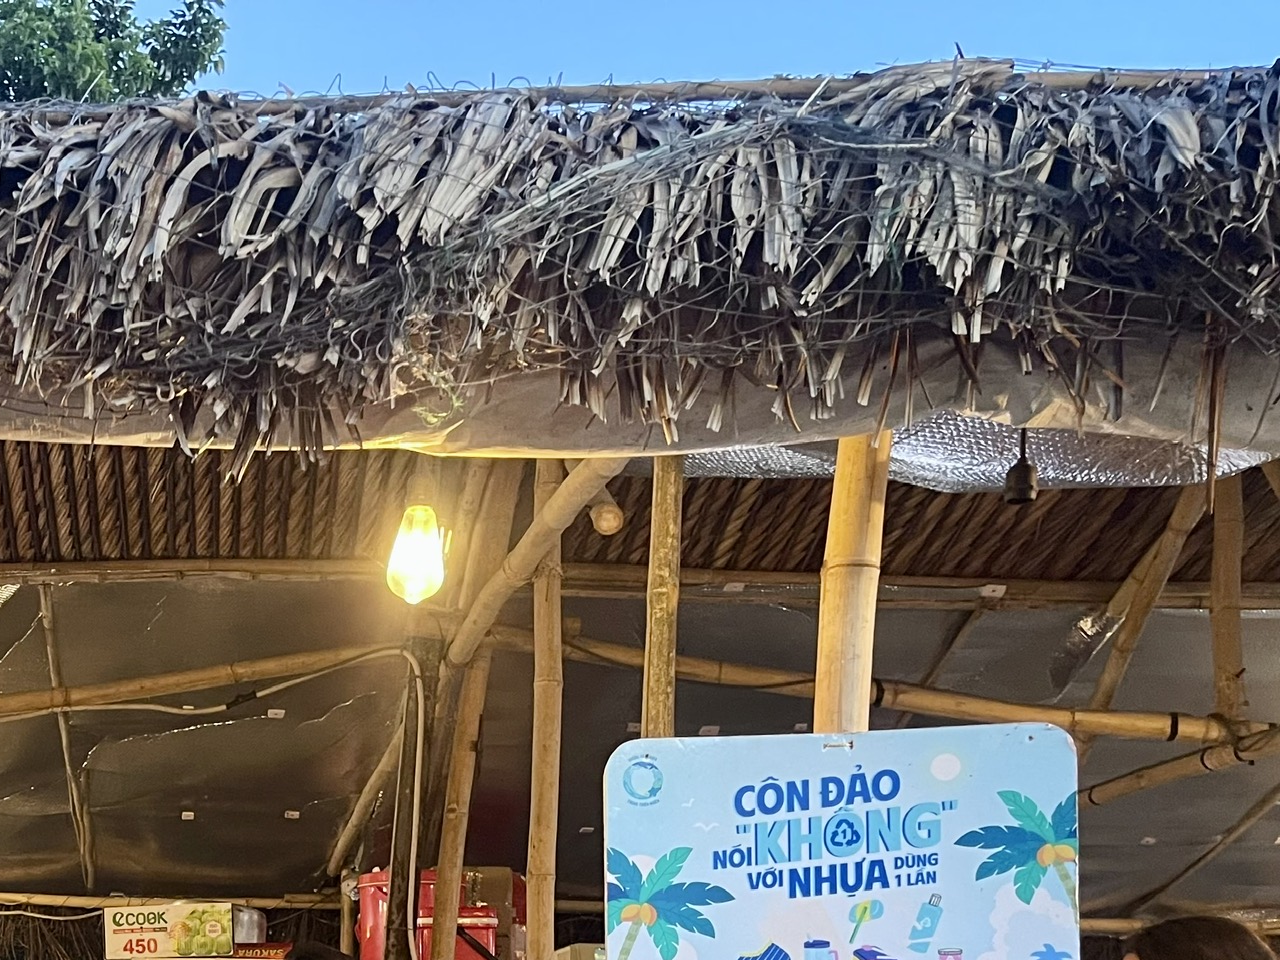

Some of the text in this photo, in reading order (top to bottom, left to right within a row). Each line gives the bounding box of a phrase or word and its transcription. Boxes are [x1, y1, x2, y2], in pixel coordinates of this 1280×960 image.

[734, 765, 901, 817] CÔN ĐẢO
[713, 844, 752, 870] NÓI
[894, 853, 938, 870] DÙNG
[747, 857, 890, 898] VỚI NHỰA
[895, 868, 936, 887] 1 LẦN
[123, 938, 158, 954] 450
